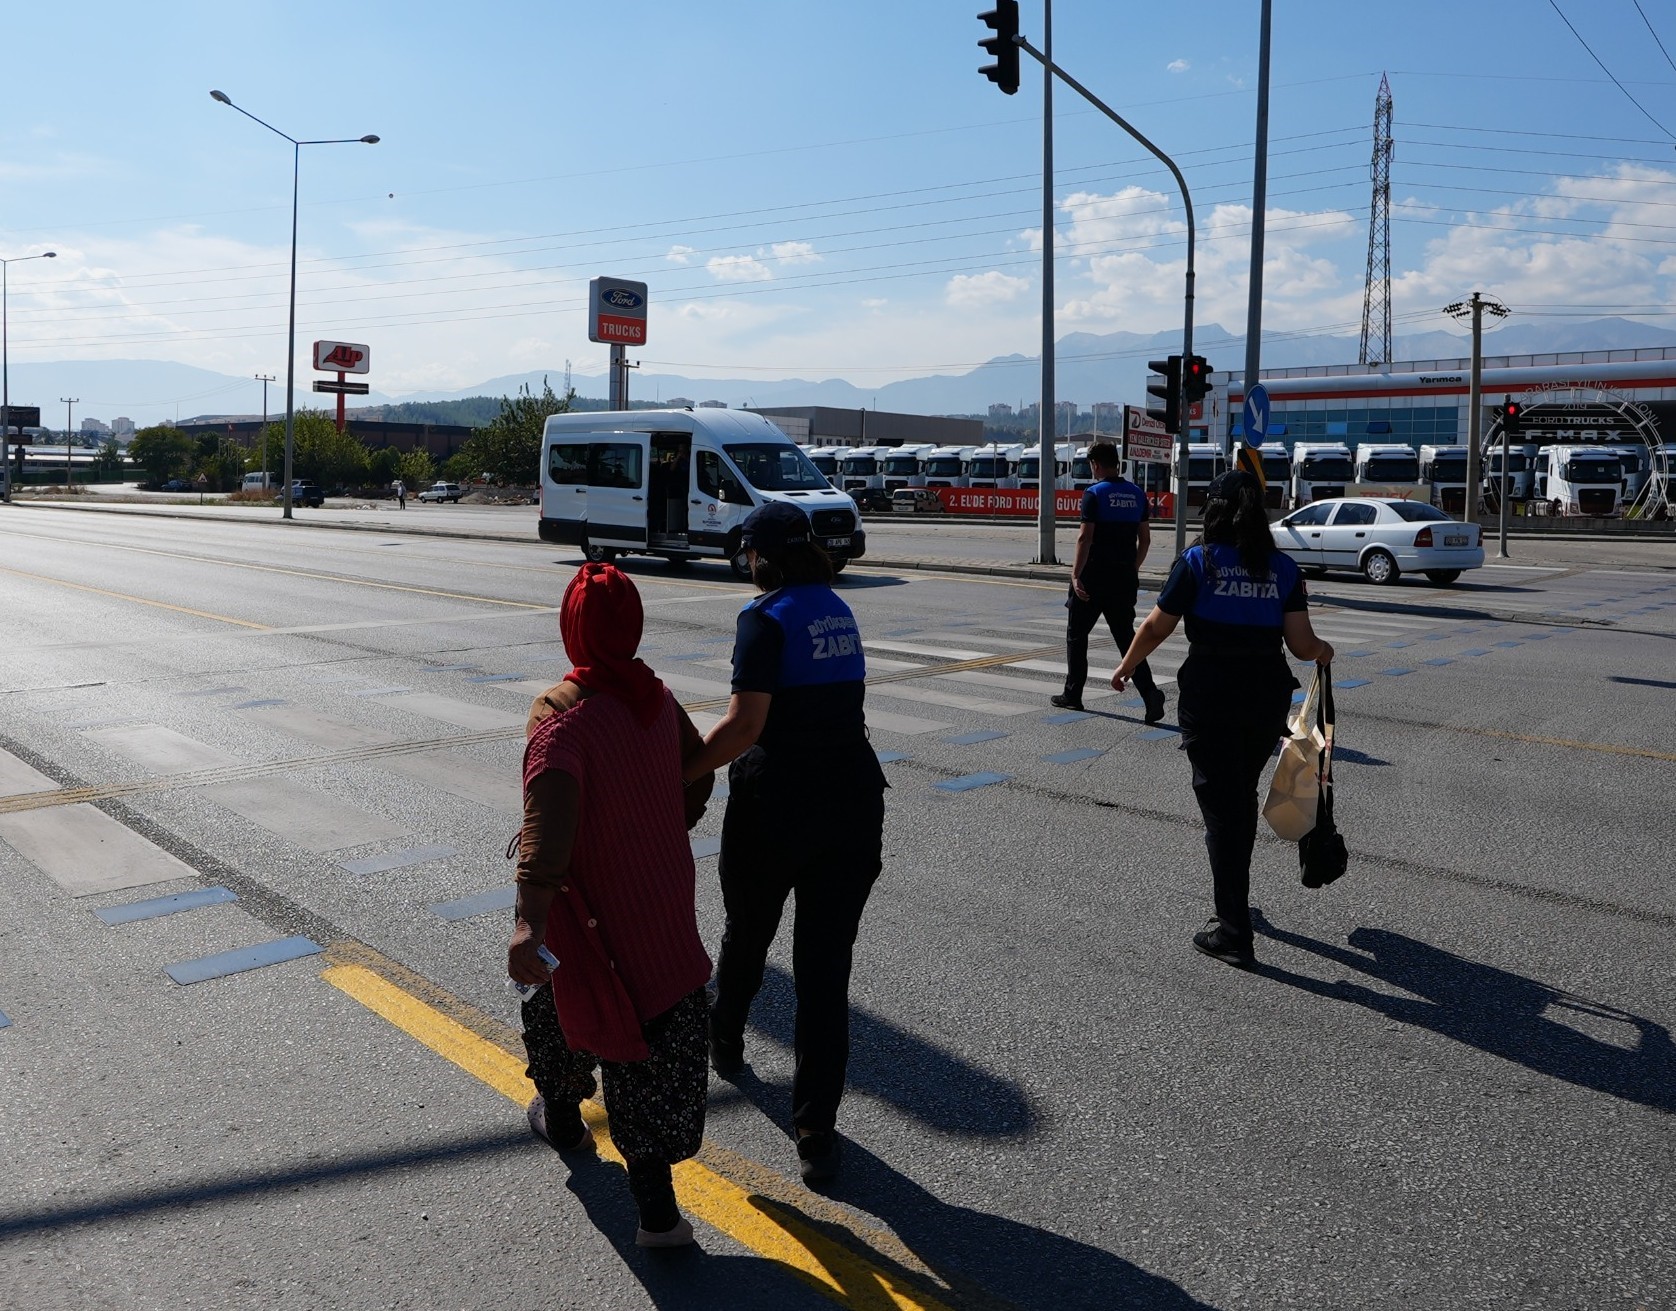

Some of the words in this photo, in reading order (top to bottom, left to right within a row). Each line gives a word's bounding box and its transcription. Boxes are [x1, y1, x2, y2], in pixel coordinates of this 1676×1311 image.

[610, 290, 635, 306] Ford
[602, 322, 641, 338] TRUCKS
[1562, 403, 1587, 411] 2019
[1532, 416, 1563, 424] FORD
[1567, 416, 1615, 425] TRUCKS
[1525, 429, 1622, 441] F-MAX
[949, 494, 958, 507] 2.
[987, 496, 1013, 509] FORD
[1016, 497, 1040, 510] TRUC
[1056, 495, 1082, 511] GÜVE
[1110, 498, 1138, 508] ZABITA
[1214, 580, 1280, 599] ZABITA
